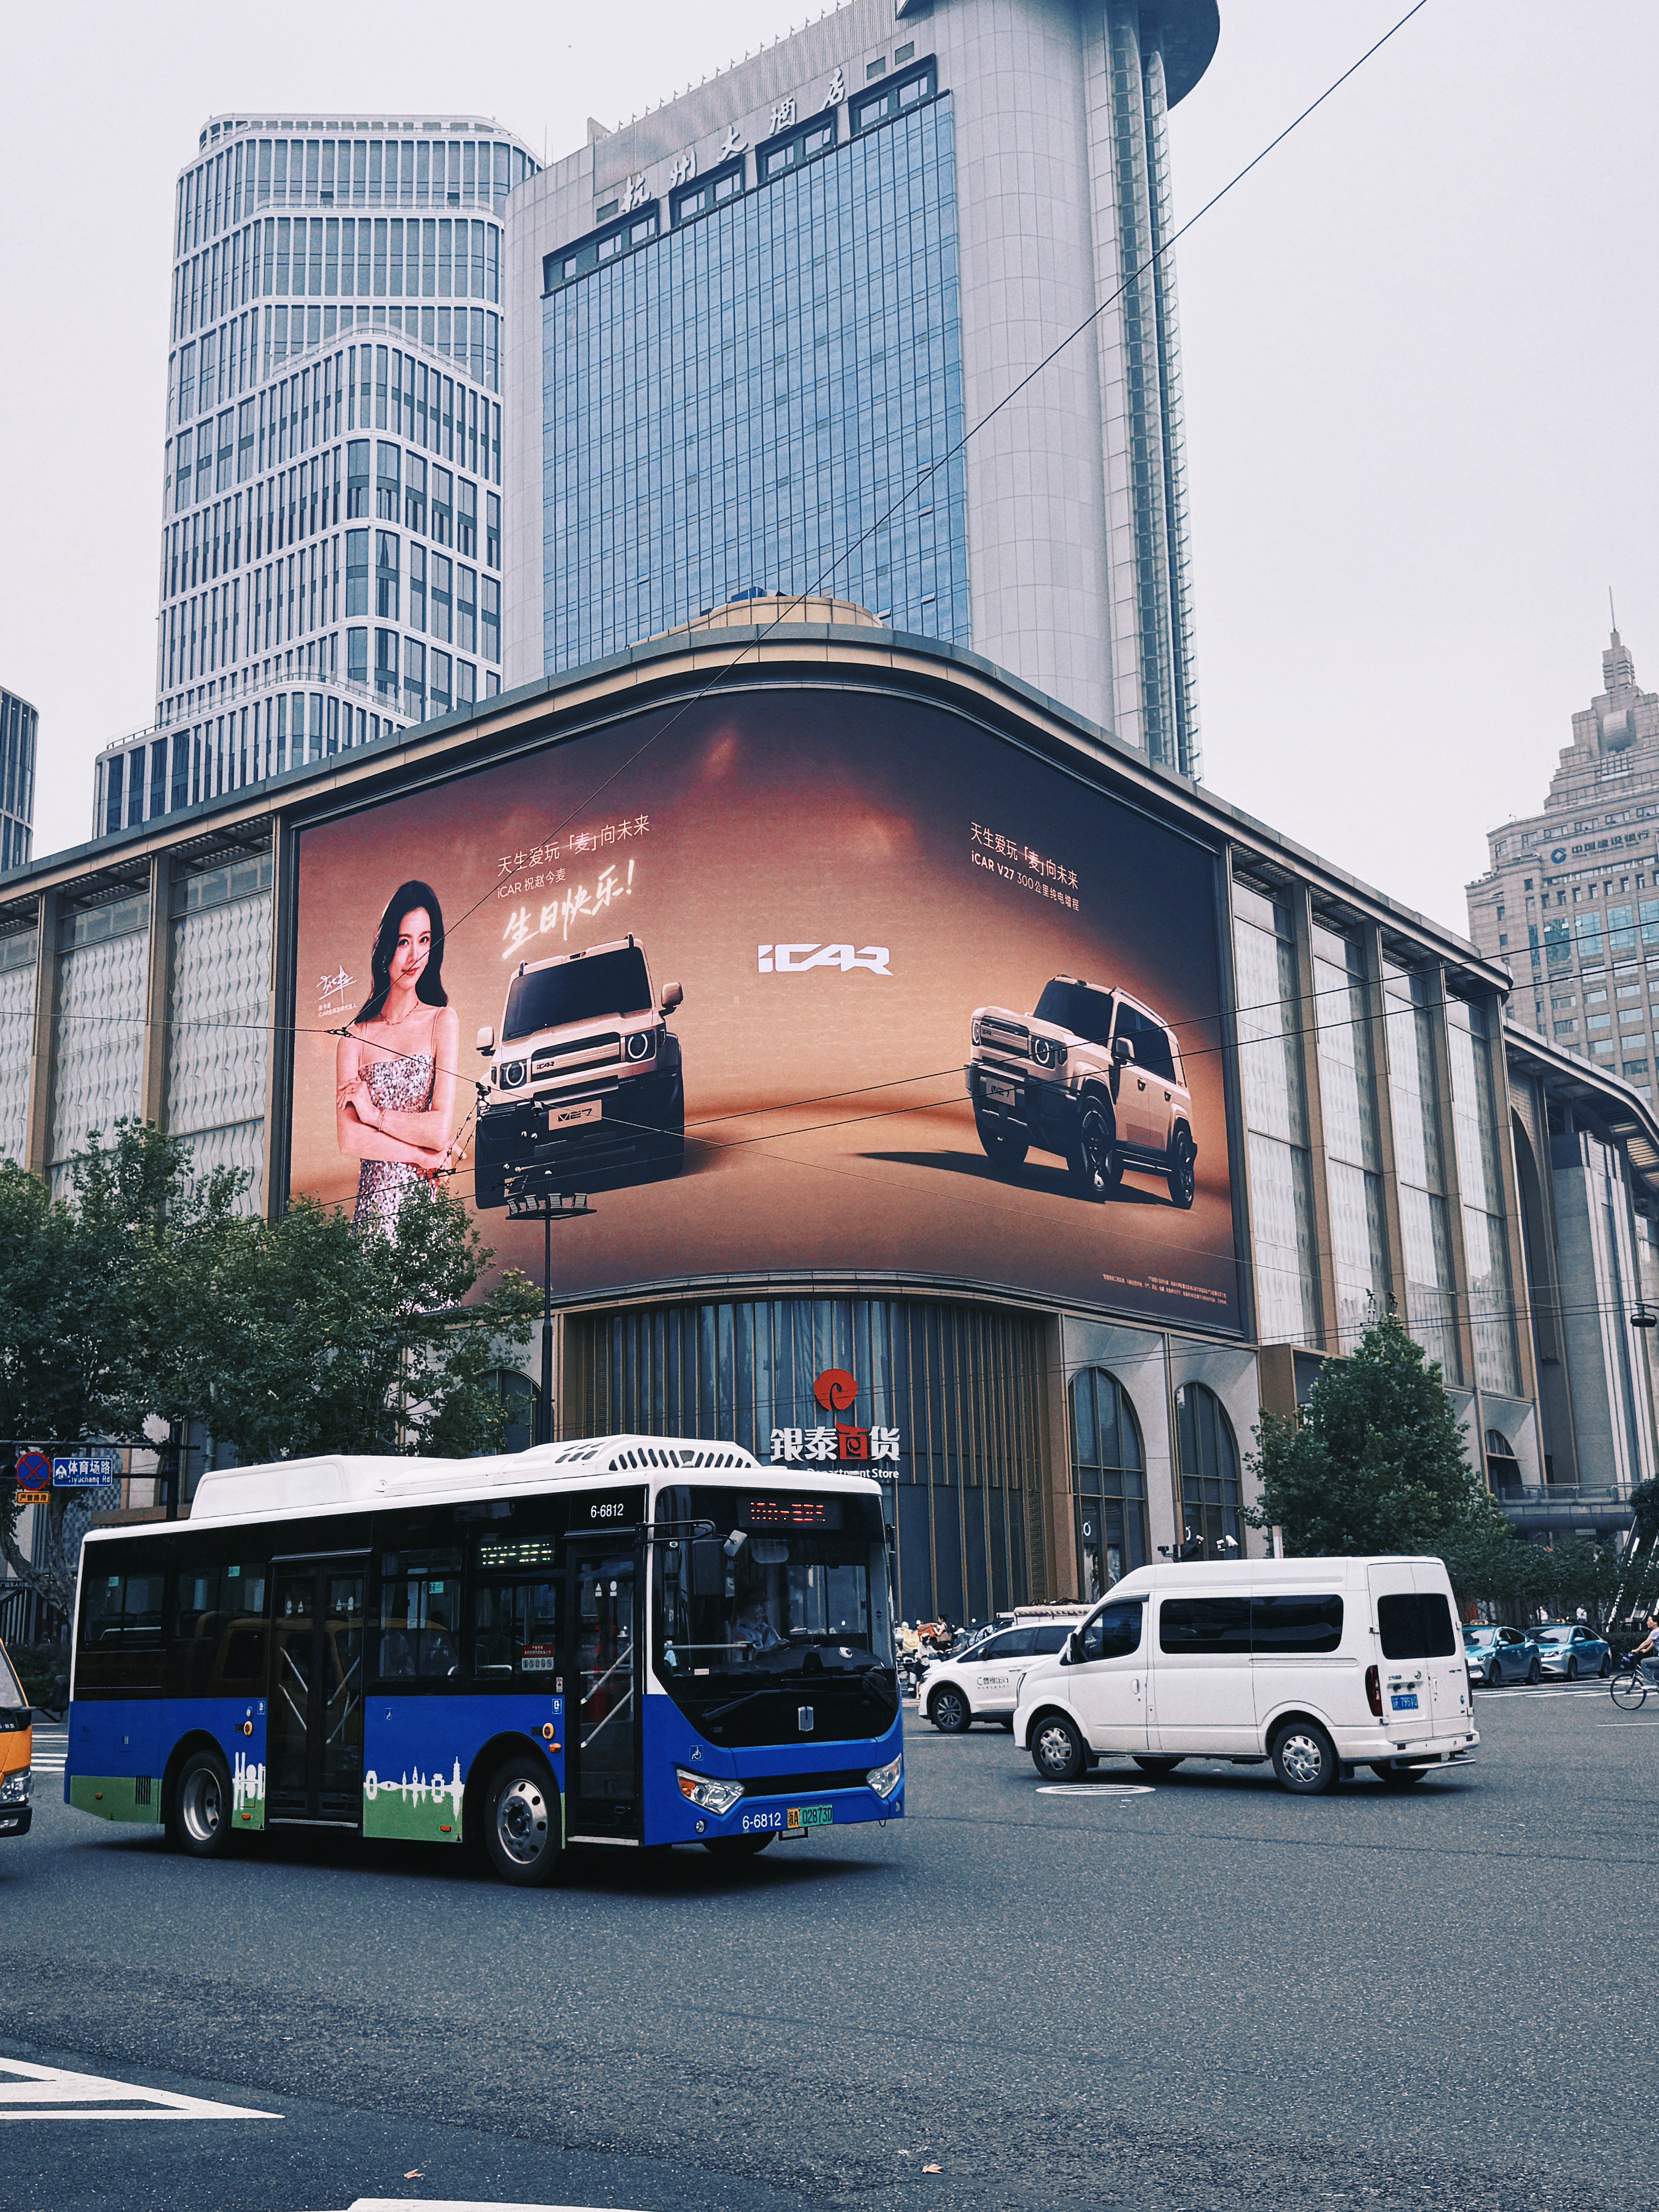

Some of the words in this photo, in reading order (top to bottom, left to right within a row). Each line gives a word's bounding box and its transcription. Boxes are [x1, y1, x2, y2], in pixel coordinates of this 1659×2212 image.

[621, 68, 845, 213] 杭州大酒店
[972, 851, 994, 872] iCAR
[997, 863, 1014, 880] V27
[498, 883, 521, 898] iCAR
[524, 868, 566, 892] 祝赵今麦
[558, 1108, 592, 1122] V27
[770, 1422, 900, 1462] 银泰百货
[68, 1460, 111, 1474] 体育场路
[872, 1468, 899, 1479] Store
[590, 1503, 624, 1518] 6-6812
[743, 1812, 781, 1830] 6-6812
